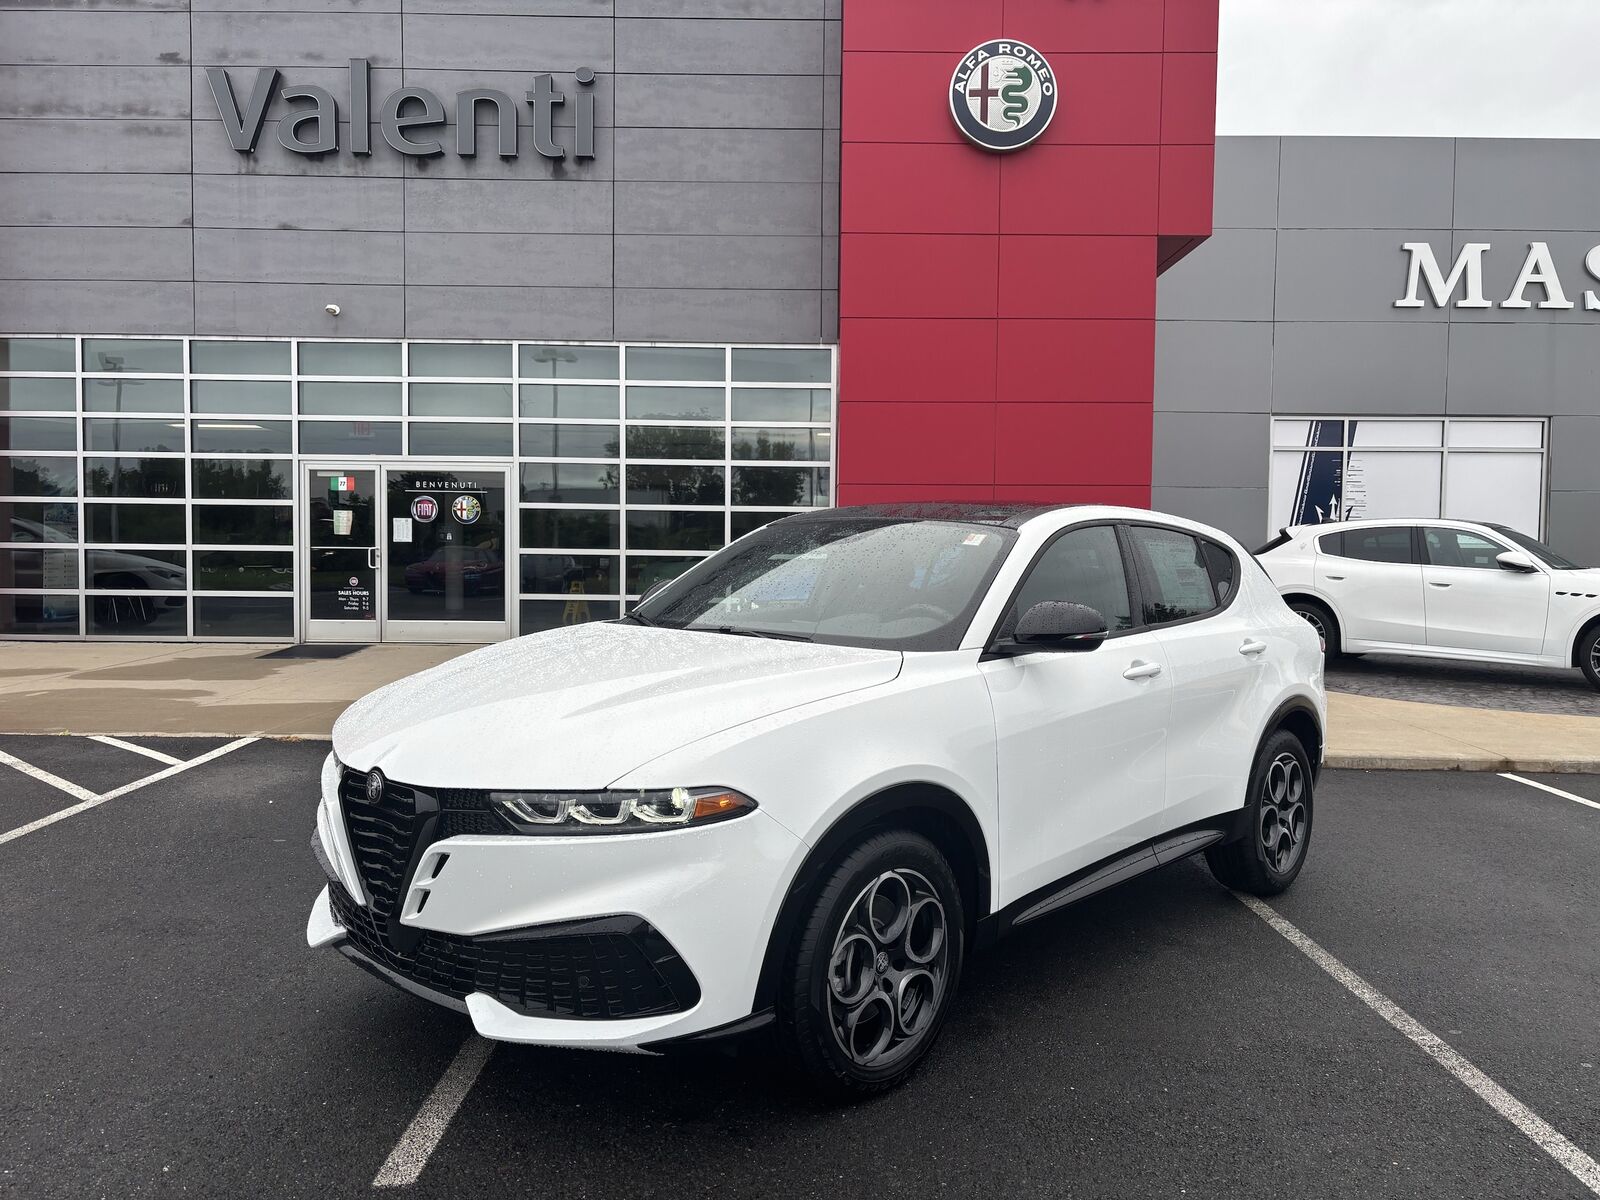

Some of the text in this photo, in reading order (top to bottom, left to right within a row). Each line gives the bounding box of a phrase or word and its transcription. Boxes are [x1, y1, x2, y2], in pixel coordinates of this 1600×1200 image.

[954, 43, 1053, 96] ALFA ROMEO
[204, 57, 596, 158] Valenti
[415, 481, 477, 489] BENVENUTI
[417, 503, 433, 516] FIAT
